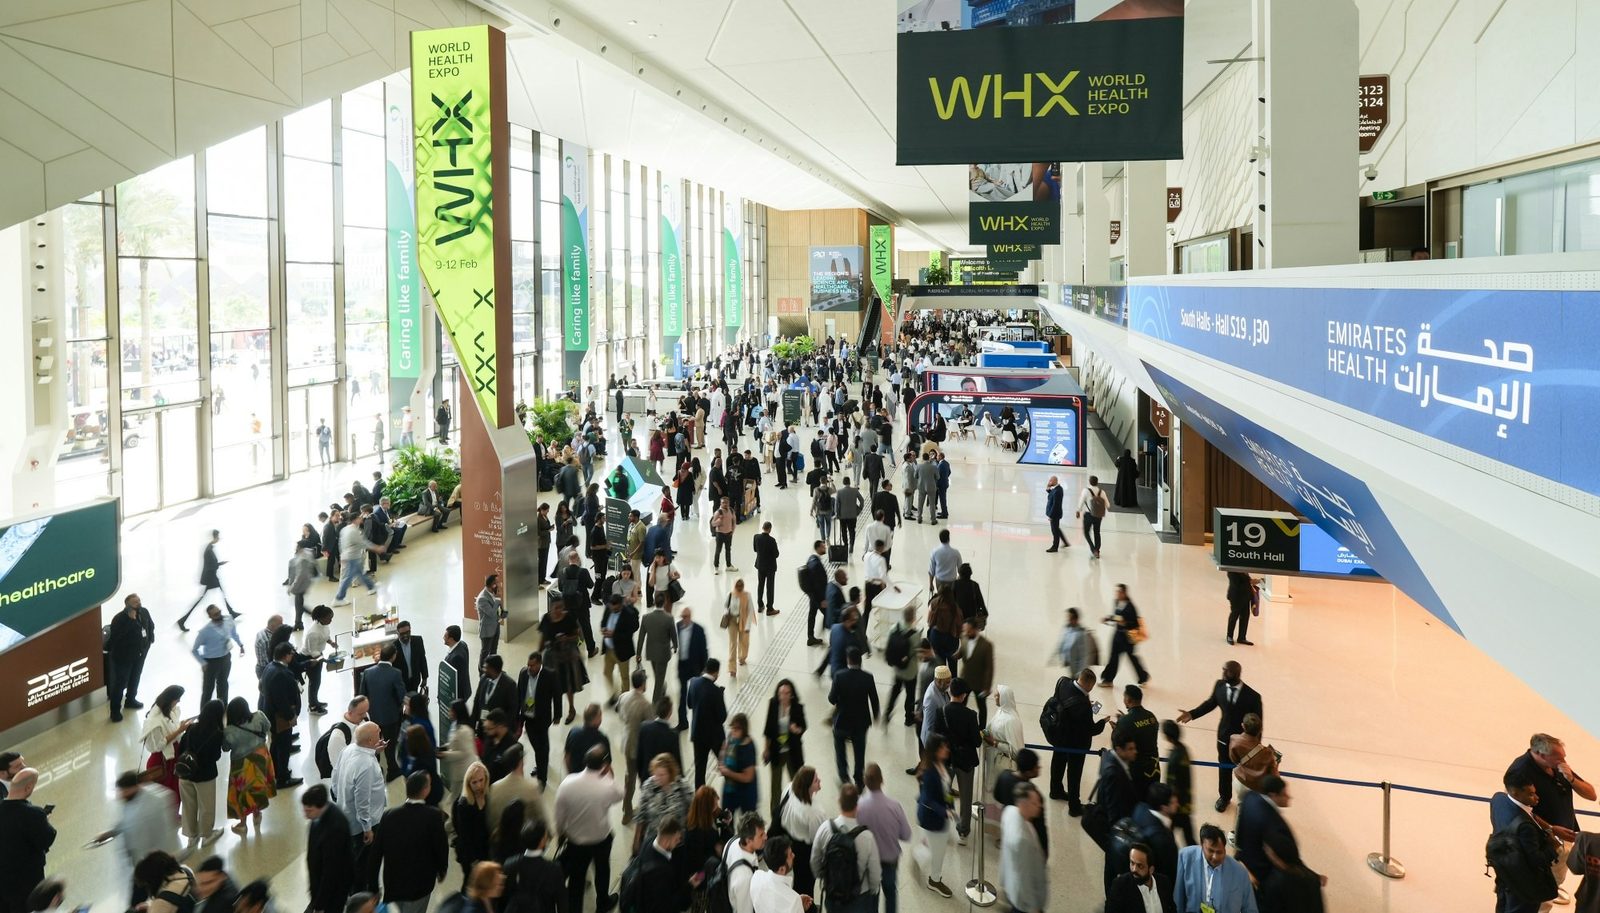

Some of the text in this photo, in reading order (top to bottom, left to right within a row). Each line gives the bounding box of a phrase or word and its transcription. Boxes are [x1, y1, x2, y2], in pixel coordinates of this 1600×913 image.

[428, 42, 471, 54] WORLD
[428, 53, 473, 66] HEALTH
[428, 67, 460, 78] EXPO
[1088, 74, 1145, 87] WORLD
[928, 71, 1081, 120] WHX
[1088, 88, 1148, 101] HEALTH
[1088, 103, 1130, 115] EXPO
[431, 89, 475, 246] WHX
[980, 216, 1029, 231] WHX
[435, 259, 478, 269] 9-12 Feb
[875, 239, 887, 275] WHX
[993, 244, 1022, 253] WHX
[397, 229, 413, 370] Caring like family
[571, 245, 583, 345] Caring like family
[668, 253, 678, 332] Caring like family
[1181, 308, 1196, 329] South
[1196, 311, 1211, 332] Halls
[1215, 313, 1229, 337] Hall
[1230, 315, 1247, 340] S19
[1252, 318, 1270, 347] J30
[1328, 320, 1407, 356] EMIRATES
[1417, 323, 1533, 373] صحة
[1328, 348, 1387, 385] HEALTH
[1394, 361, 1531, 439] الإمارات
[1226, 521, 1266, 548] 19
[1228, 549, 1285, 562] South Hall
[0, 567, 95, 608] healthcare
[28, 696, 43, 707] DUBAI
[44, 685, 71, 700] EXHIBITION
